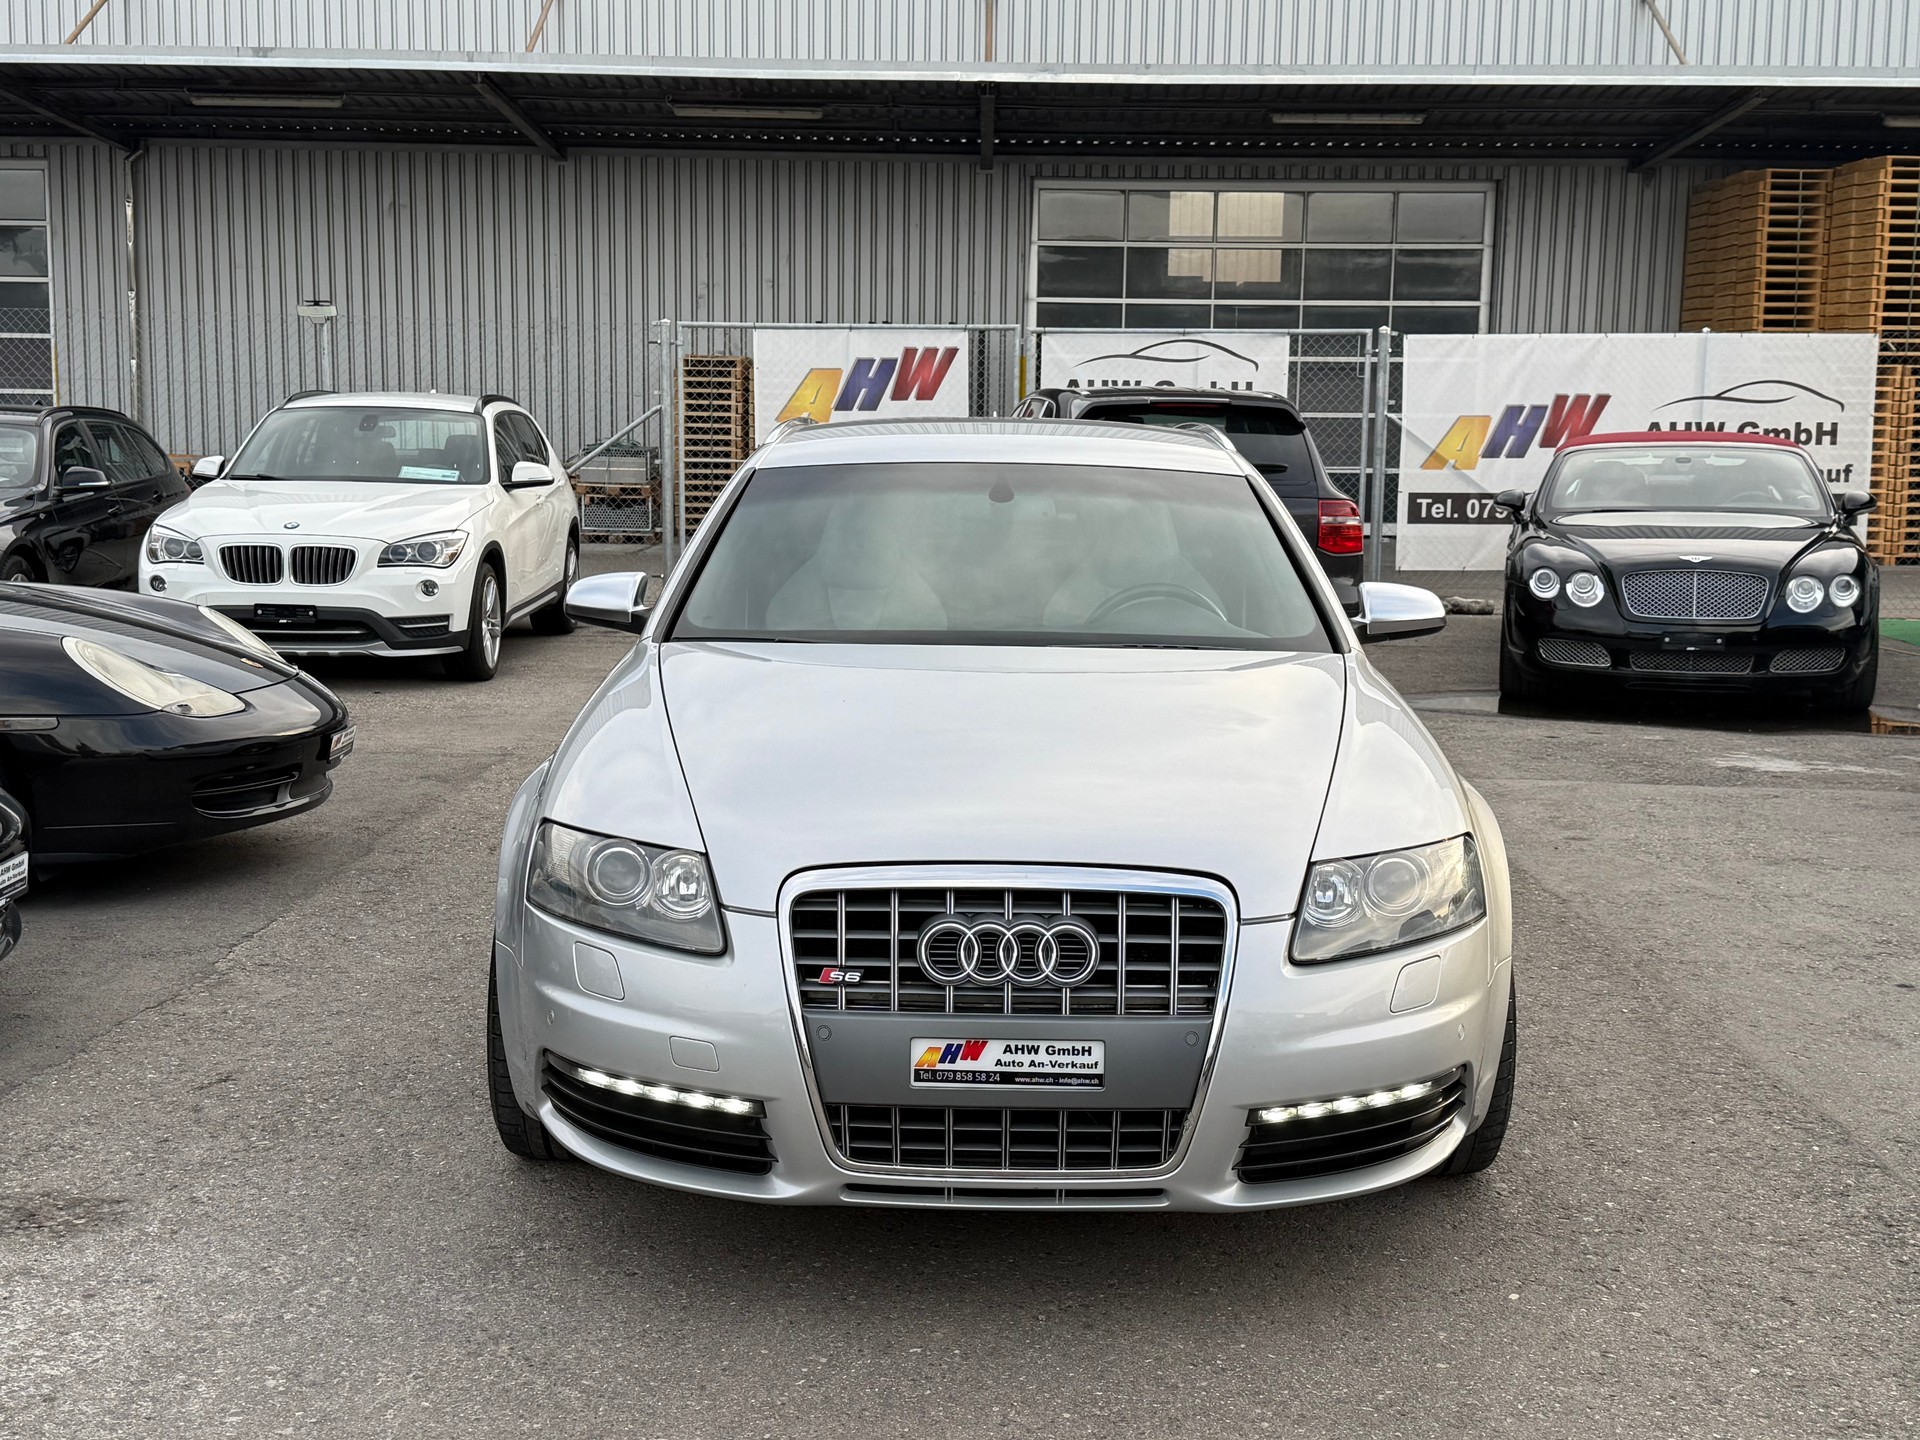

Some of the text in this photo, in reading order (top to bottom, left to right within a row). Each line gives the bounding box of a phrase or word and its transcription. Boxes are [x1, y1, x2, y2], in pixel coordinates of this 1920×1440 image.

[774, 346, 960, 423] AHW
[1419, 393, 1612, 471] AHW
[1416, 498, 1458, 518] Tel.
[828, 971, 861, 982] S6
[914, 1040, 988, 1068] AHW
[1002, 1044, 1092, 1057] AHW GmbH
[994, 1058, 1099, 1070] Auto An-Verkauf
[919, 1070, 1000, 1082] Tel. 079 858 58 24
